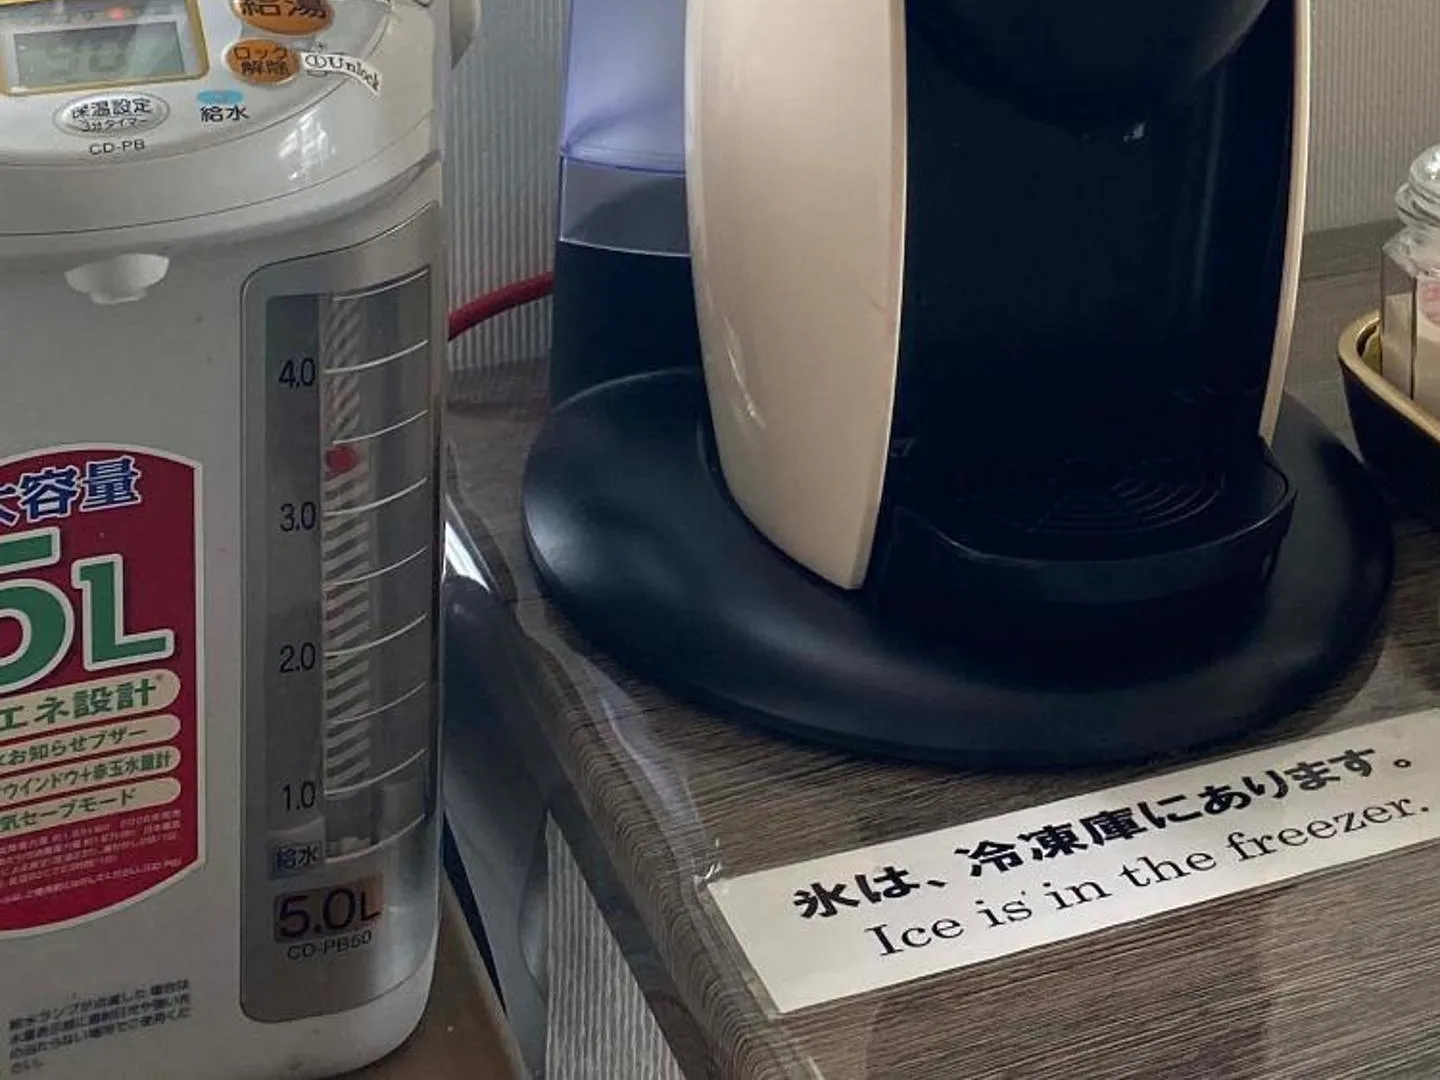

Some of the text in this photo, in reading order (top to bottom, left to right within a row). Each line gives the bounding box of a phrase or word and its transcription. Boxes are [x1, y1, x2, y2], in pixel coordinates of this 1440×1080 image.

[233, 45, 289, 60] ロック
[241, 58, 291, 77] 解除
[71, 97, 153, 120] 保温設定
[200, 104, 250, 123] 給水
[89, 138, 146, 156] CD-PB
[278, 358, 318, 388] 4.0
[279, 502, 317, 532] 3.0
[278, 642, 317, 674] 2.0
[282, 781, 316, 812] 1.0
[792, 743, 1414, 921] 氷は、冷凍庫にあります。
[276, 843, 321, 871] 給水
[864, 791, 1432, 959] Ice is in the freezer.
[279, 887, 382, 938] 5.0L
[286, 930, 373, 961] CD-PB50
